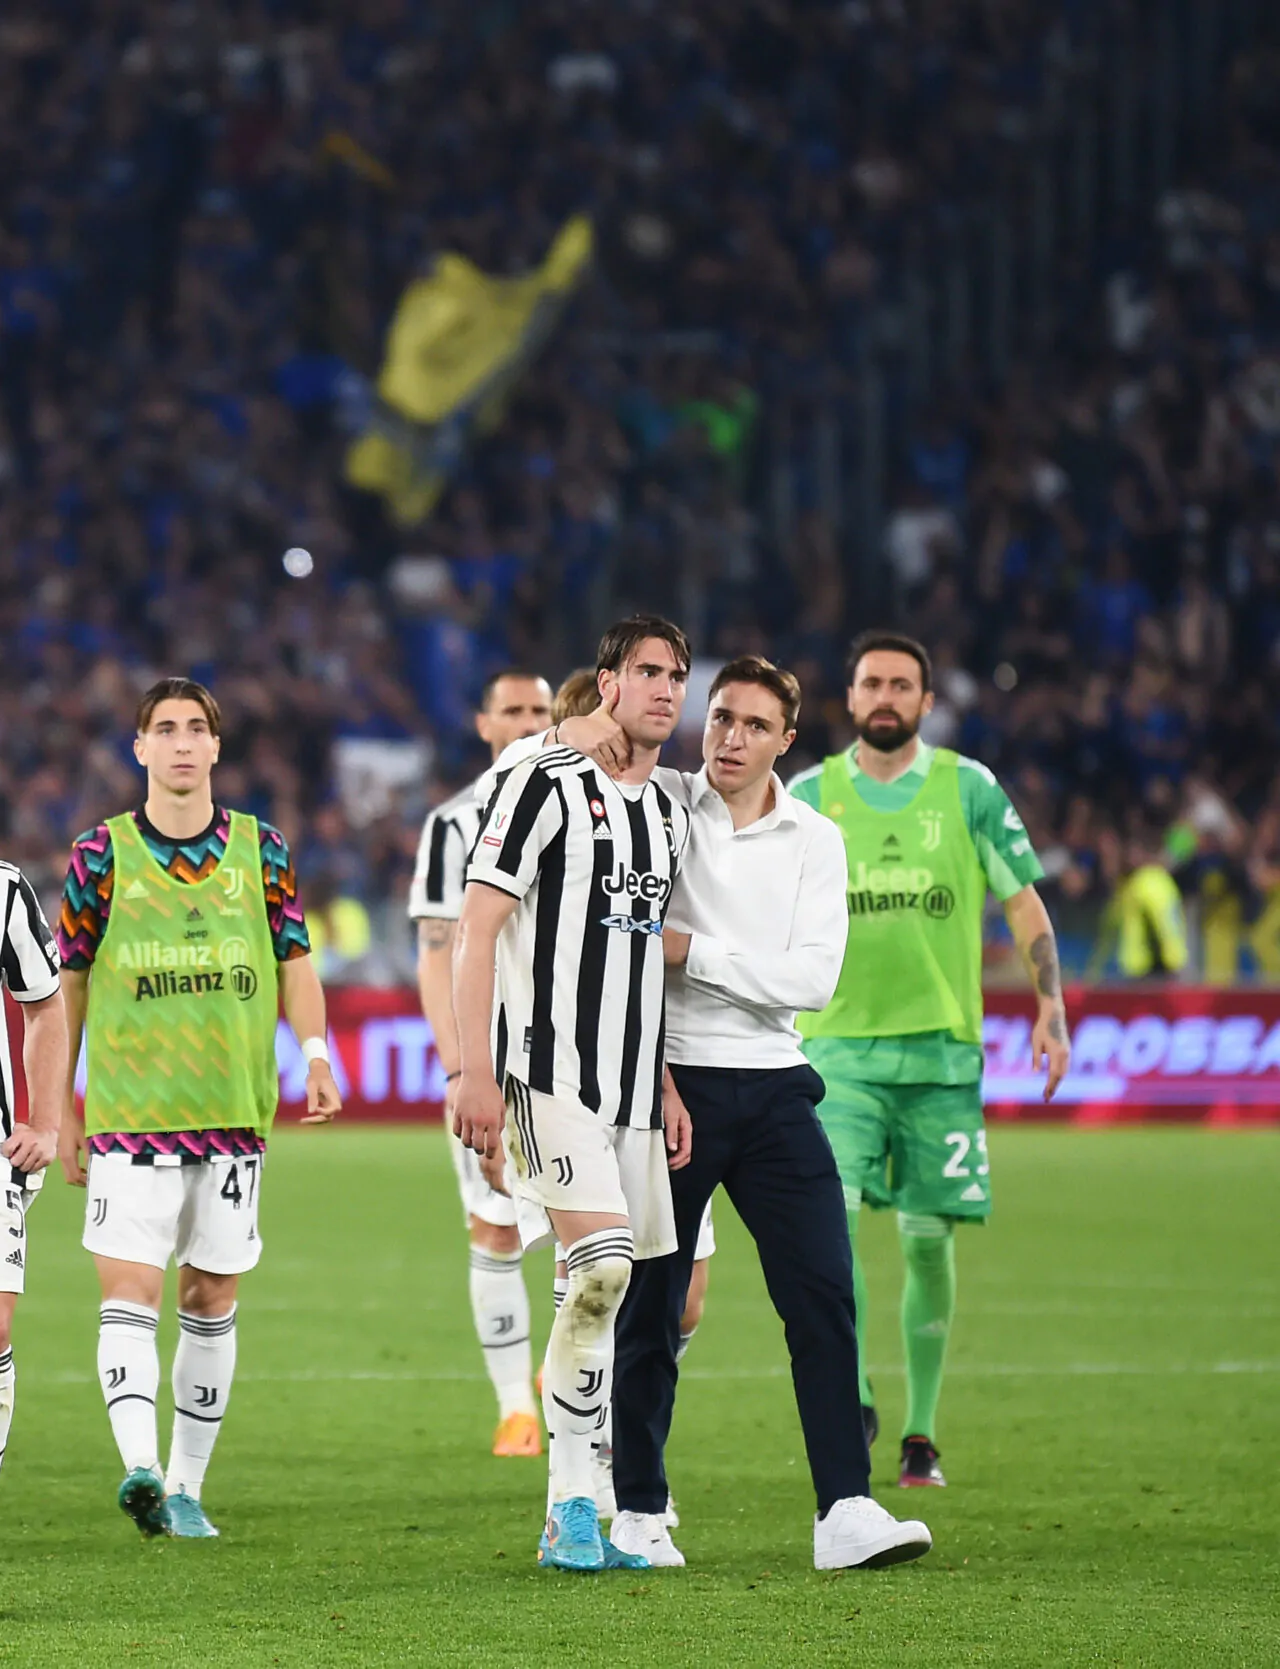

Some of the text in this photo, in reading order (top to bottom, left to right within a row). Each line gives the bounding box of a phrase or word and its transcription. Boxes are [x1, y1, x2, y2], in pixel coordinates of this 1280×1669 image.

[847, 889, 919, 915] llianz
[184, 929, 208, 939] Jeep
[117, 940, 214, 969] Allianz
[135, 970, 225, 1001] Allianz
[220, 1160, 257, 1210] 47
[5, 1189, 24, 1239] 5
